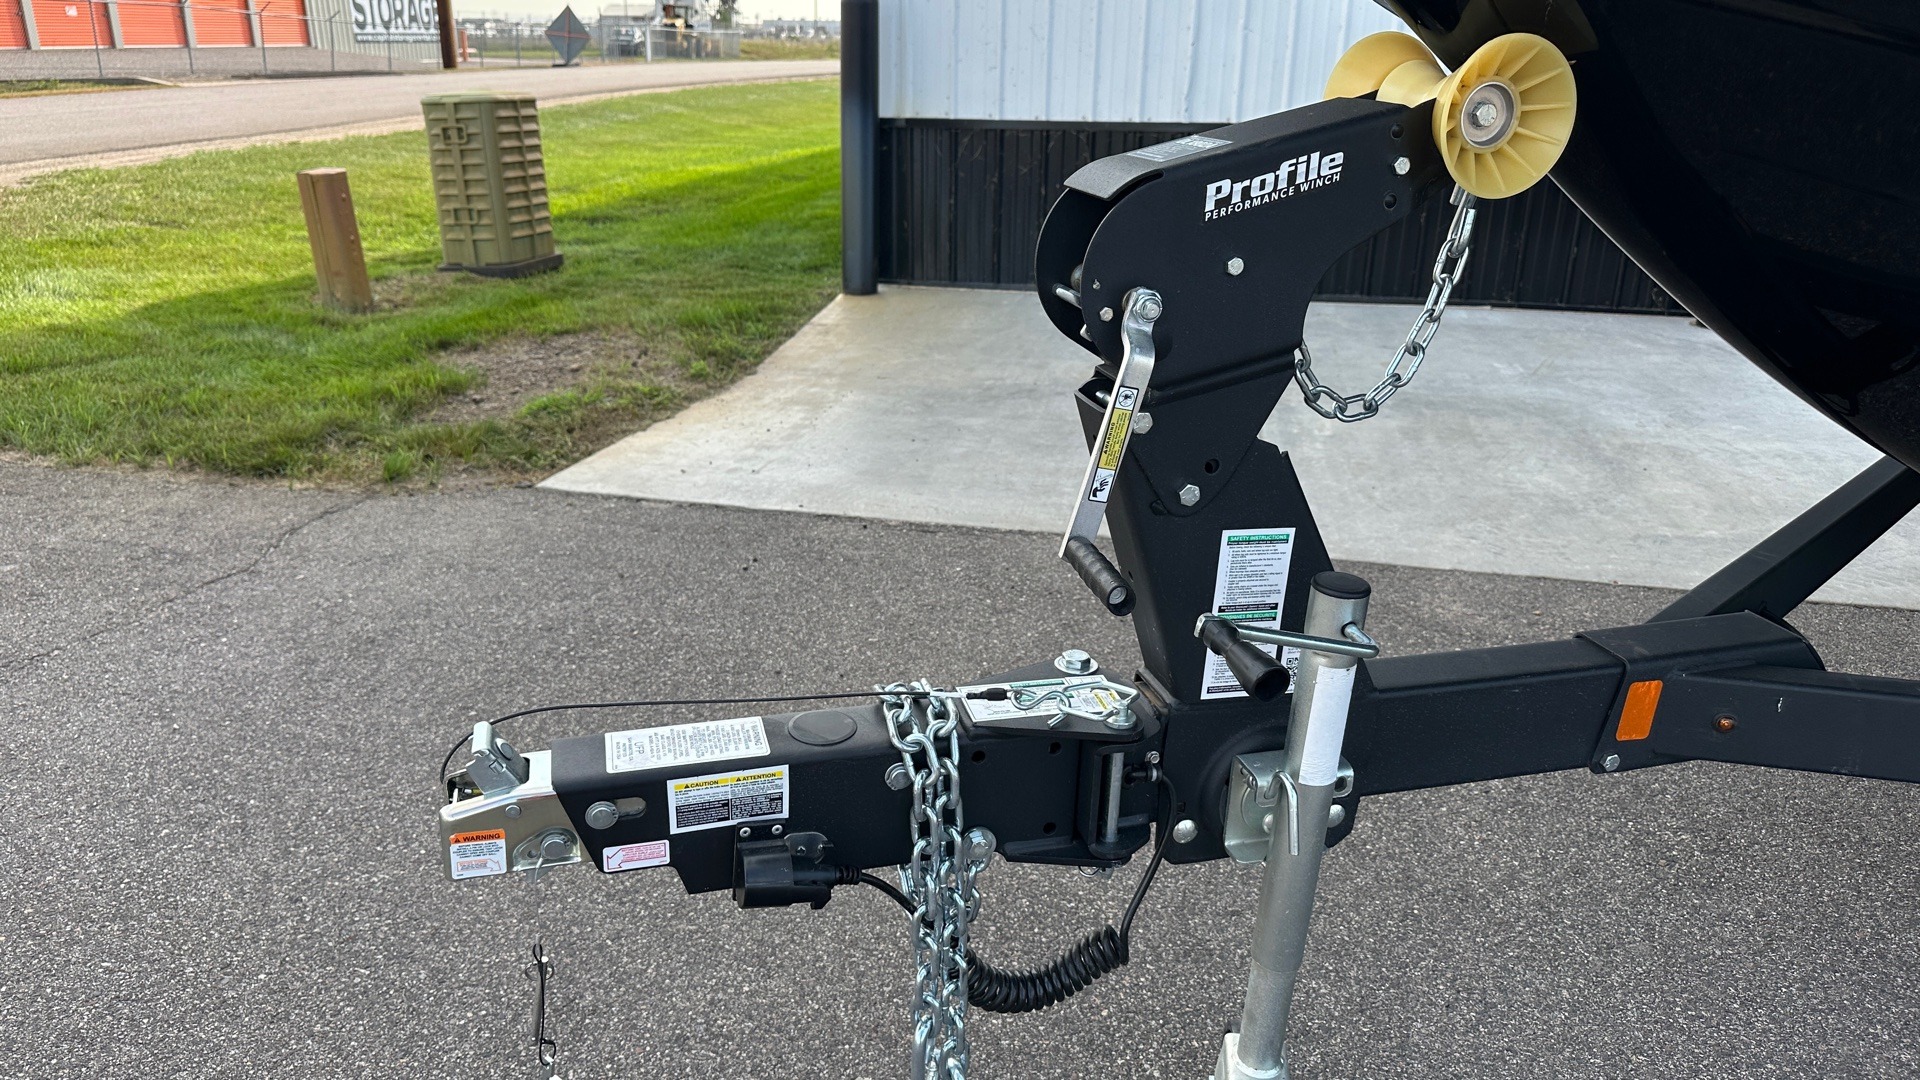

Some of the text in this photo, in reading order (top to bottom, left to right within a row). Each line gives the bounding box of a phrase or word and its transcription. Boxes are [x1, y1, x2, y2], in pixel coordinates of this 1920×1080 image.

[1204, 151, 1344, 212] Profile
[1205, 172, 1341, 221] PERFORMANCE WINCH
[634, 741, 645, 754] UFP
[690, 772, 777, 788] CAUTION ATTENTION
[462, 833, 501, 842] WARNING
